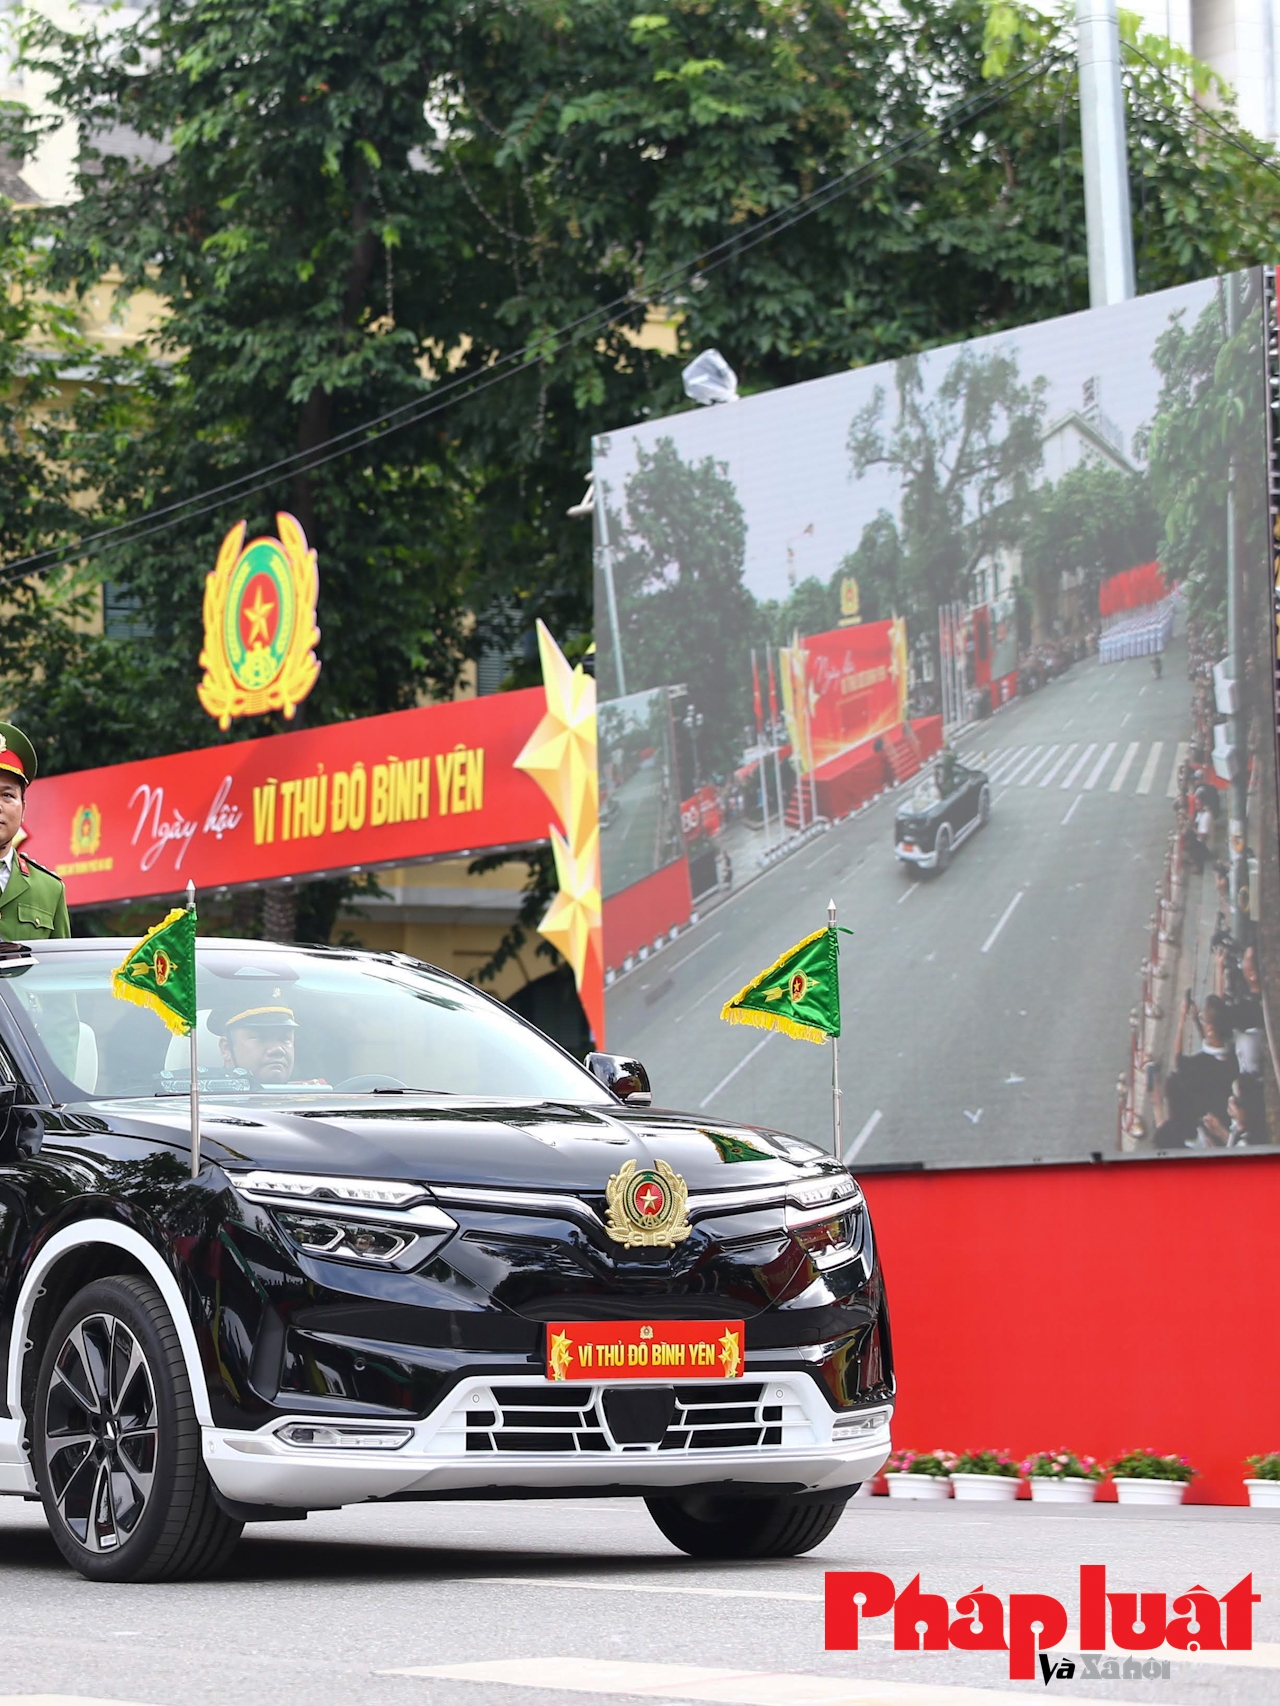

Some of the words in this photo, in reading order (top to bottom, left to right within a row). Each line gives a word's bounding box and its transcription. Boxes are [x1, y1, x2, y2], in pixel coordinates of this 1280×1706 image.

[127, 784, 198, 872] Ngày
[203, 775, 243, 840] hội
[253, 777, 277, 845] VÌ
[280, 762, 328, 841] THỦ
[331, 761, 367, 832] ĐÔ
[370, 755, 430, 826] BÌNH
[435, 743, 485, 816] YÊN
[578, 1342, 593, 1367] VÌ
[596, 1339, 625, 1367] THỦ
[628, 1341, 648, 1366] ĐÔ
[652, 1341, 685, 1366] BÌNH
[689, 1341, 715, 1366] YÊN
